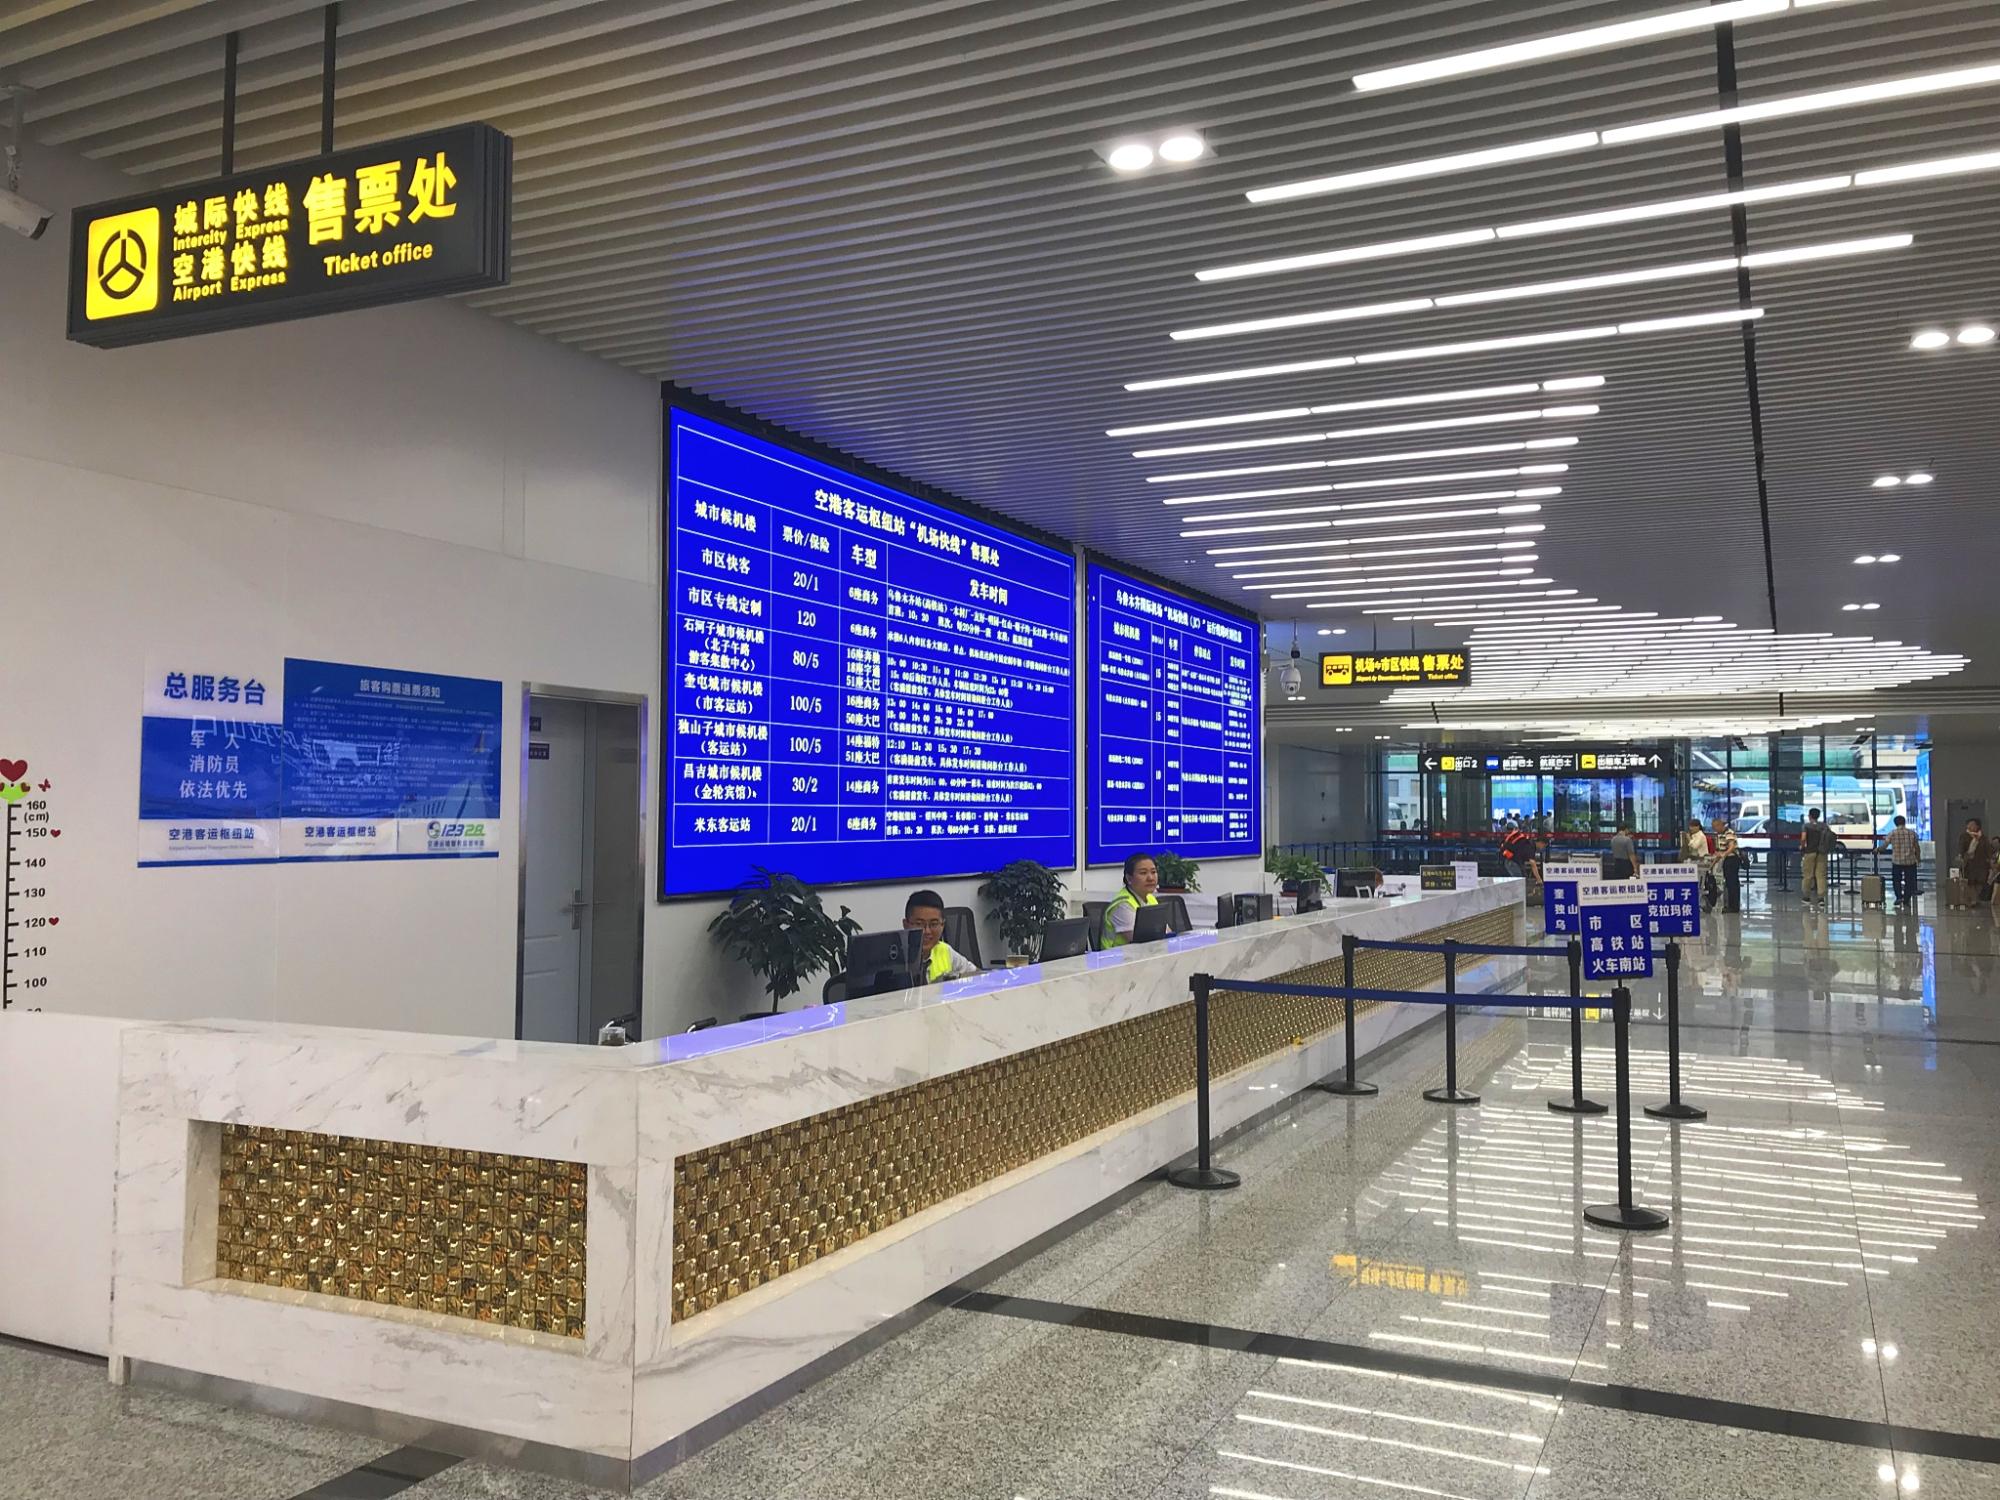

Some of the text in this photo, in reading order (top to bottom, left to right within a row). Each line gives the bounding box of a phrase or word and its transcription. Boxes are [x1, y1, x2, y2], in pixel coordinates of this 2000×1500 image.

[302, 152, 457, 245] 售票处
[173, 182, 289, 235] 城际快线
[173, 218, 289, 252] Intercity Express
[172, 234, 288, 286] 空港快线
[323, 242, 433, 276] Ticket office
[173, 271, 286, 302] Airport Express
[694, 499, 757, 534] 城市候机楼
[782, 525, 830, 554] 票价/保险
[701, 547, 751, 575] 市区快客
[851, 544, 878, 570] 车型
[793, 570, 819, 592] 20/1
[688, 586, 763, 618] 市区专线定制
[797, 610, 816, 627] 120
[683, 617, 765, 645] 石河子城市候机楼
[792, 650, 820, 669] 80/5
[1380, 655, 1420, 673] 市区快线
[1422, 654, 1464, 672] 售票处
[164, 672, 266, 706] 总服务台
[684, 672, 764, 696] 奎屯城市候机楼
[790, 695, 822, 714] 100/5
[678, 718, 768, 741] 独山子城市候机楼
[790, 736, 822, 754] 100/5
[189, 754, 240, 774] 消防员
[683, 763, 763, 781] 昌吉城市候机楼
[179, 779, 248, 800] 依法优先
[792, 777, 819, 793] 30/2
[26, 801, 47, 810] 160
[24, 812, 49, 823] (cm)
[694, 817, 751, 833] 米东客运站
[791, 815, 817, 832] 20/1
[25, 827, 47, 838] 150
[168, 827, 255, 841] 空港客运枢纽站
[304, 825, 377, 838] 空港客运枢纽站
[24, 857, 46, 868] 140
[1545, 865, 1598, 875] 空港客运枢纽站
[1642, 867, 1696, 876] 空港客运枢纽站
[24, 887, 46, 898] 130
[1582, 882, 1645, 896] 空港客运枢纽站
[1647, 888, 1692, 901] 石河子
[1648, 904, 1692, 917] 克拉玛依
[24, 917, 46, 928] 120
[1588, 914, 1642, 931] 市区
[24, 946, 46, 957] 110
[1590, 935, 1645, 952] 高铁站
[1592, 956, 1646, 974] 火车南站
[24, 977, 47, 988] 100
